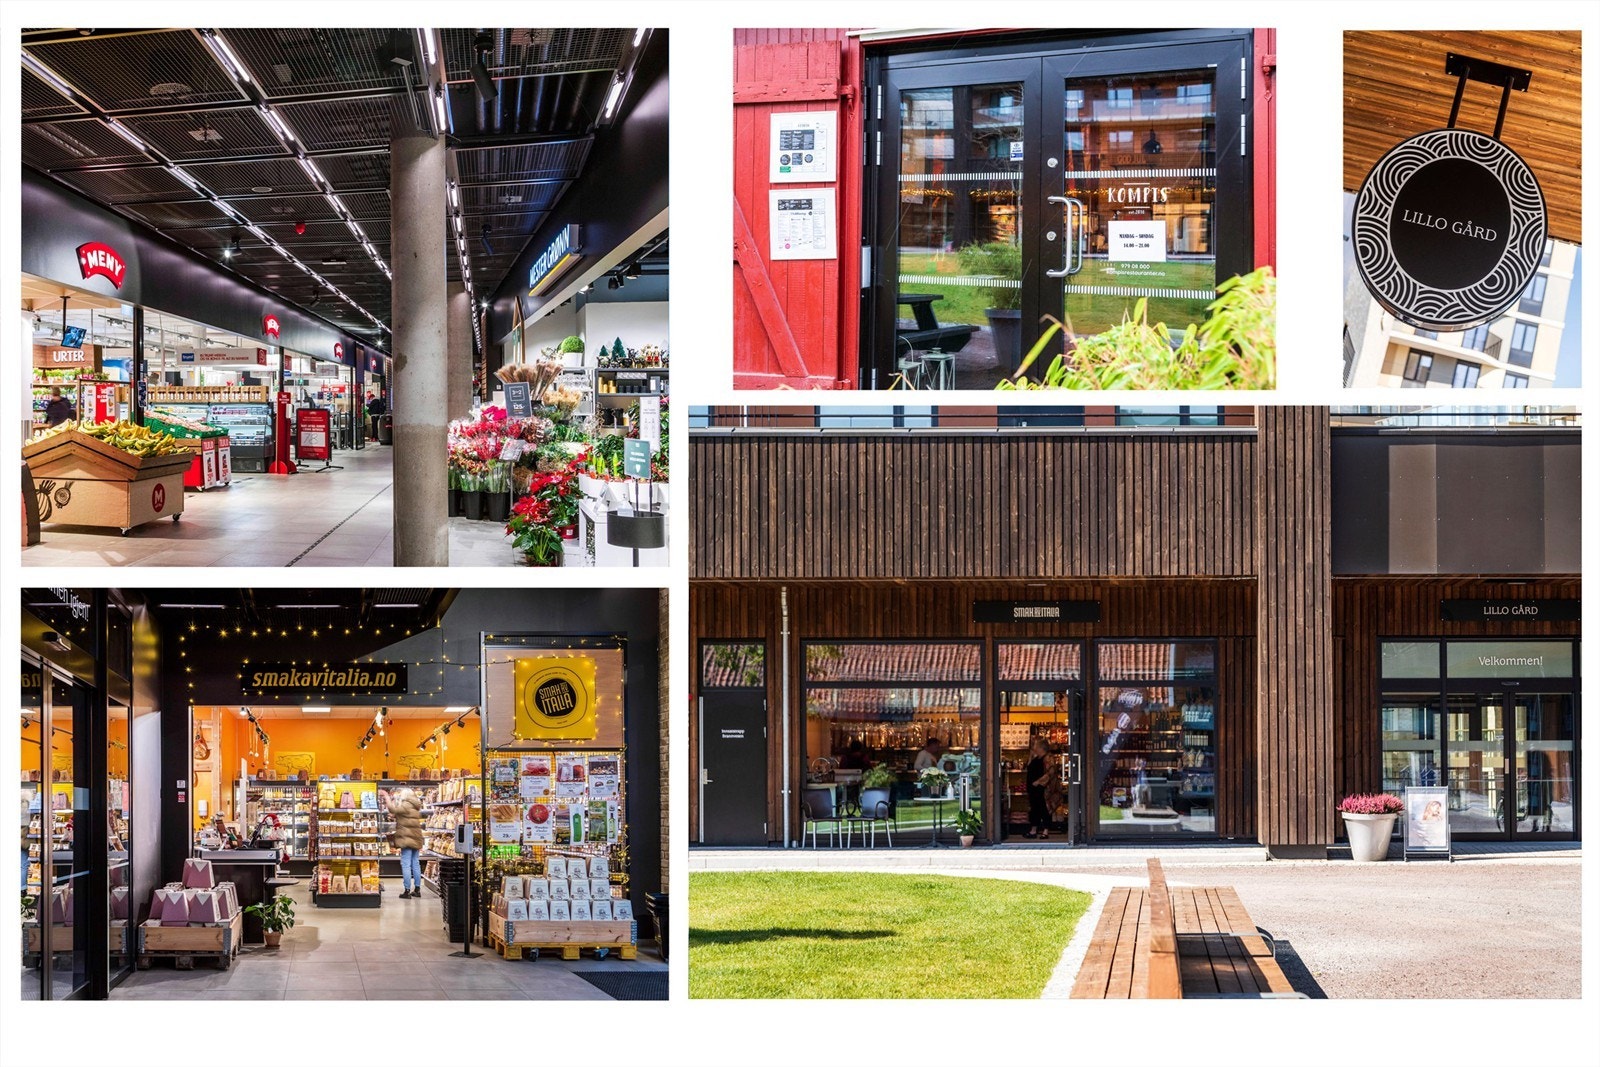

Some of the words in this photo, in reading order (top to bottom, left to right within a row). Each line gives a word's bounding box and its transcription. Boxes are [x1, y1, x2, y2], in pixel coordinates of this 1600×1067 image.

[1108, 187, 1168, 203] KOMPIS
[1402, 209, 1448, 230] LILLO
[1451, 220, 1497, 243] GÅRD
[86, 249, 122, 277] MENY
[529, 250, 548, 288] MESTER
[53, 350, 85, 363] URTER
[1483, 606, 1509, 615] LILLO
[1511, 604, 1538, 615] GÅRD
[1478, 655, 1543, 666] Velkommen!
[252, 668, 397, 687] smakavitalia.no
[538, 684, 562, 700] SMAK
[541, 692, 574, 715] ITALIA
